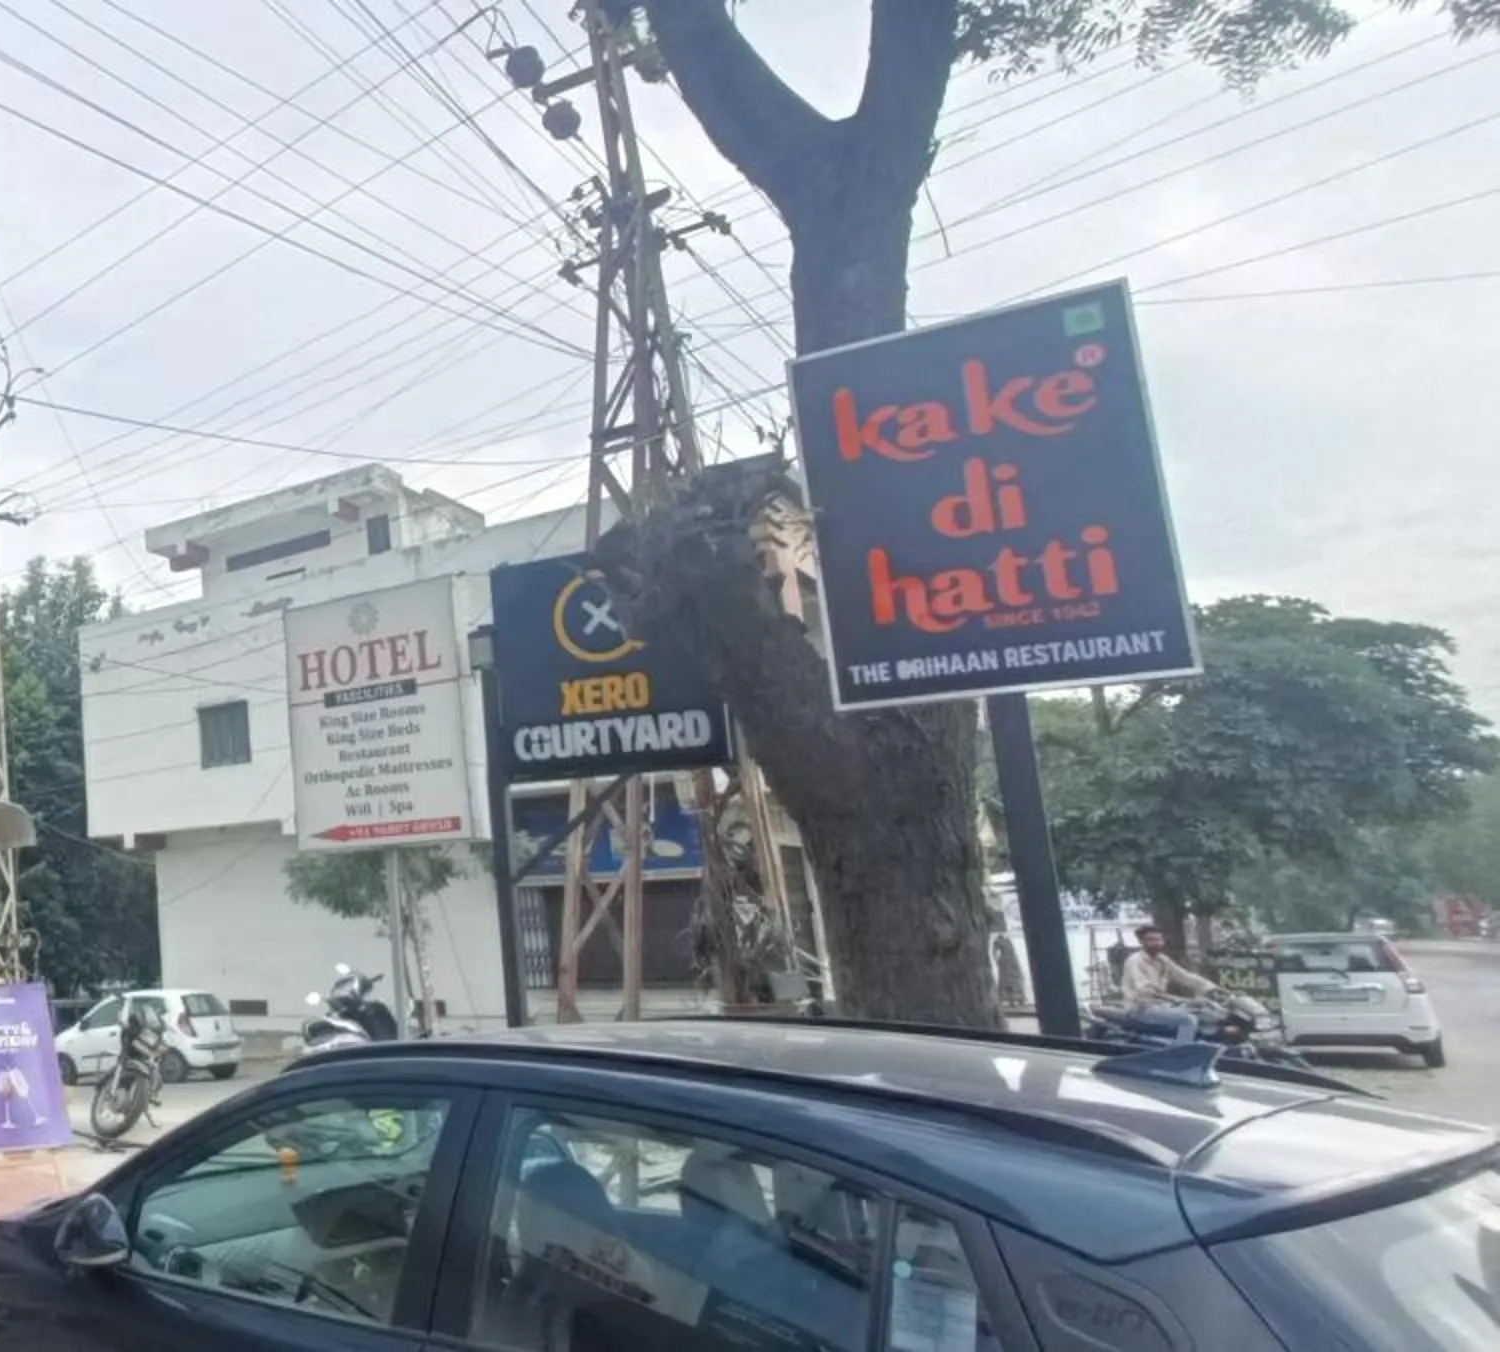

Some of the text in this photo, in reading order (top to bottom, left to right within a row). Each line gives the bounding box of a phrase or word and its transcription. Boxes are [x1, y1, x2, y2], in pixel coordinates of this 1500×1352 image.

[834, 358, 1097, 462] kake
[931, 456, 1027, 538] di
[867, 525, 1119, 633] hatti
[984, 607, 1045, 628] SINCE
[297, 629, 442, 691] HOTEL
[848, 662, 892, 685] THE
[1004, 630, 1166, 670] RESTAURANT
[380, 703, 426, 718] Rooms
[561, 672, 650, 717] XERO
[388, 721, 420, 737] Beds
[514, 709, 712, 761] COURTYARD
[339, 743, 411, 762] Restaurant
[304, 757, 453, 785] Orthopedic Mattresses
[365, 781, 410, 796] Rooms
[388, 800, 414, 815] Spa
